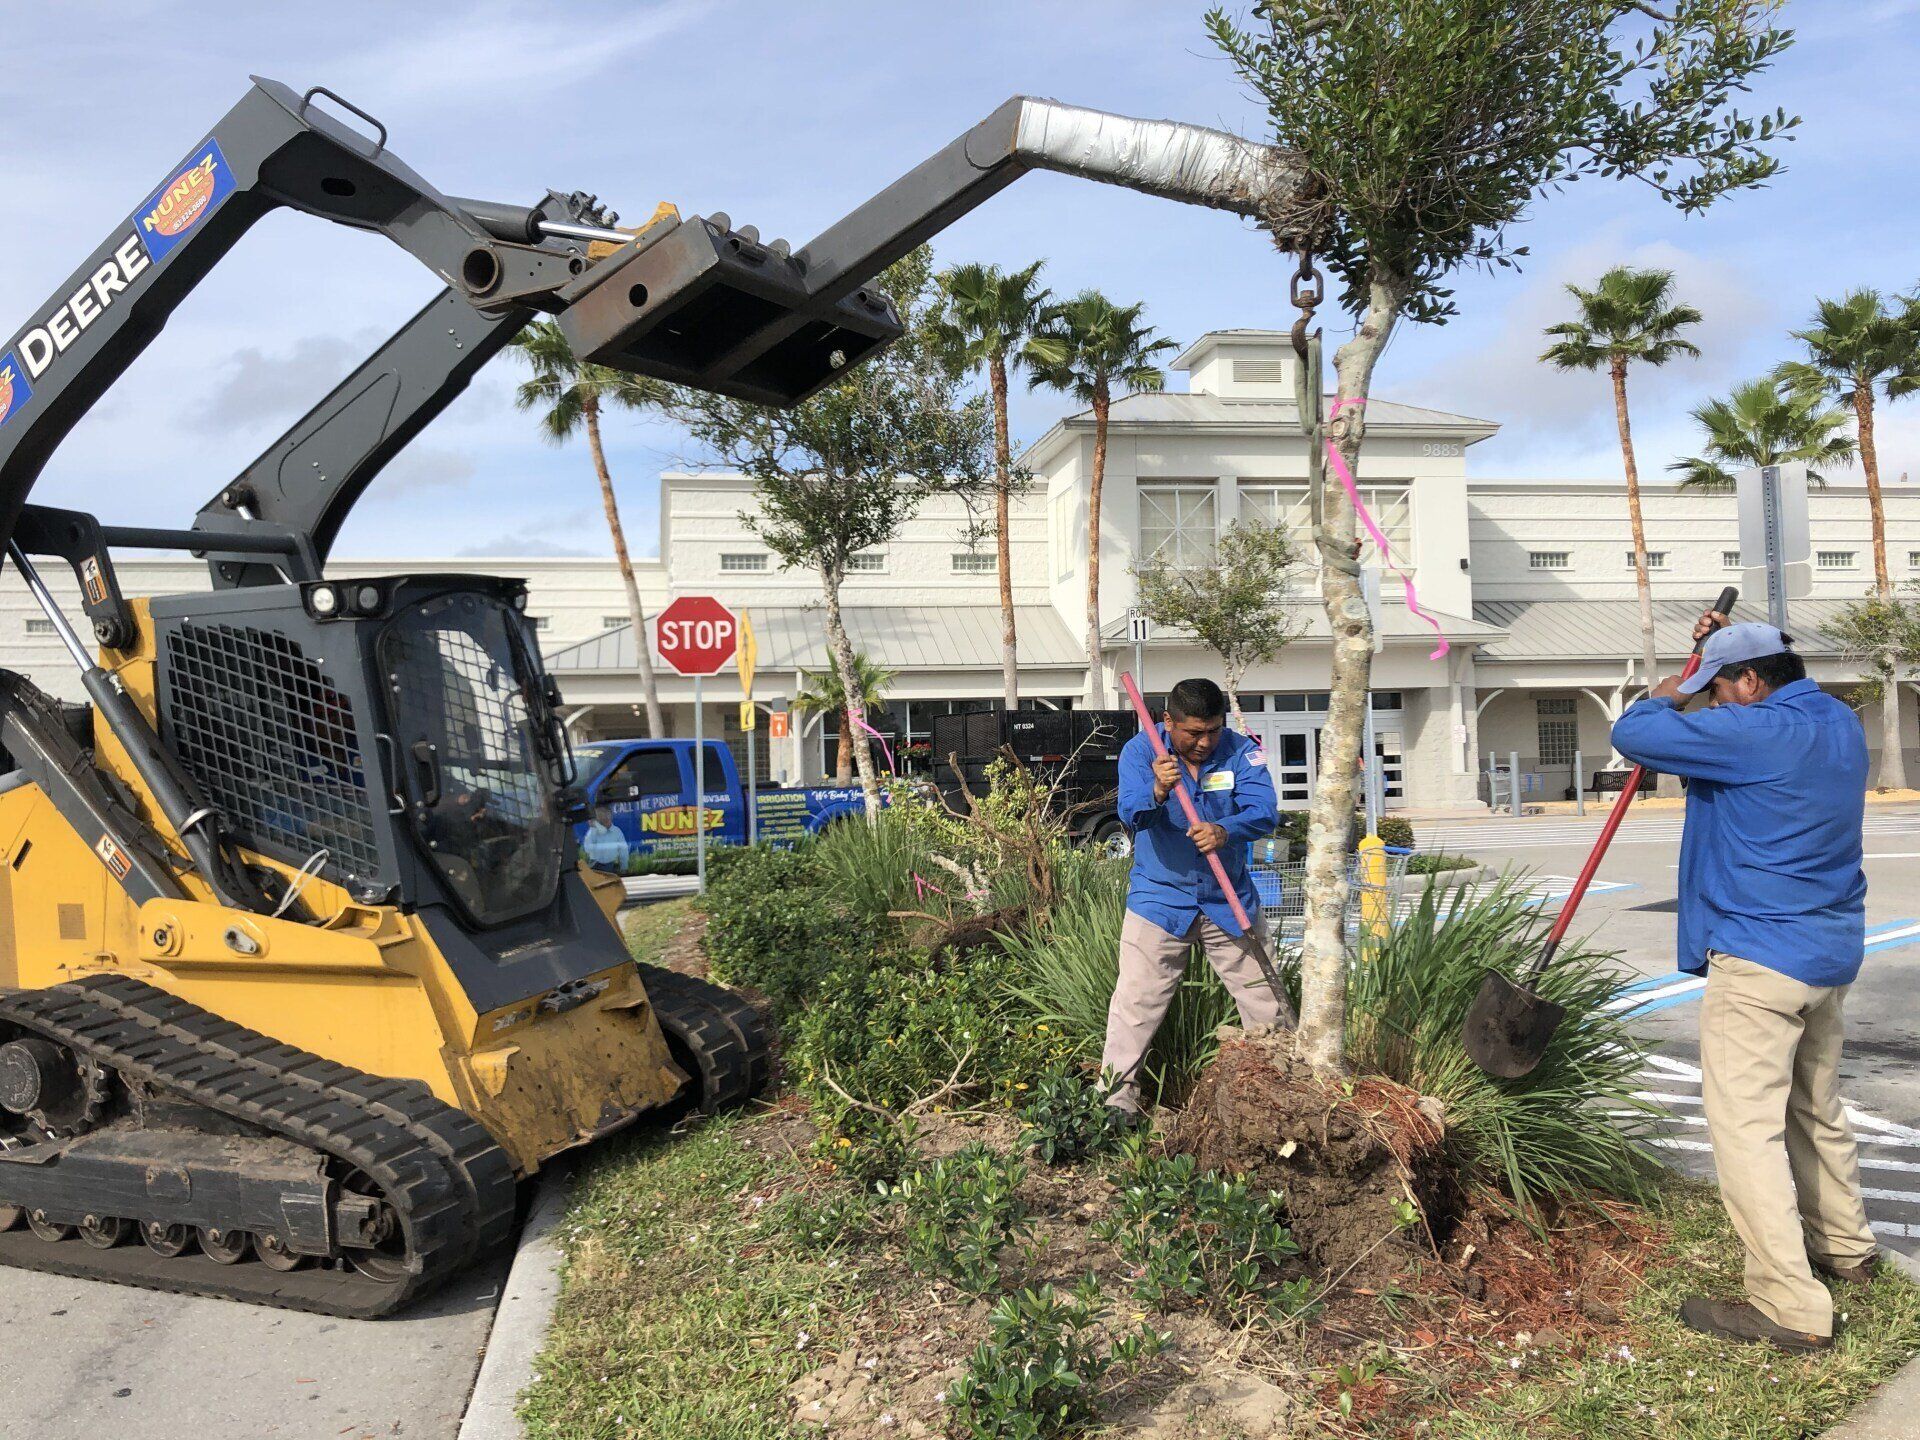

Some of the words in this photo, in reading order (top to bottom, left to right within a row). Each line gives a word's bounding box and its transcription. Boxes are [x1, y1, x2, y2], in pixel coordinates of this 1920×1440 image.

[143, 153, 218, 233] NUNEZ
[18, 234, 149, 379] DEERE
[1422, 443, 1459, 457] 9885
[661, 620, 732, 650] STOP
[1133, 619, 1146, 640] 11
[756, 793, 806, 804] IRRIGATION
[641, 809, 725, 832] NUNEZ
